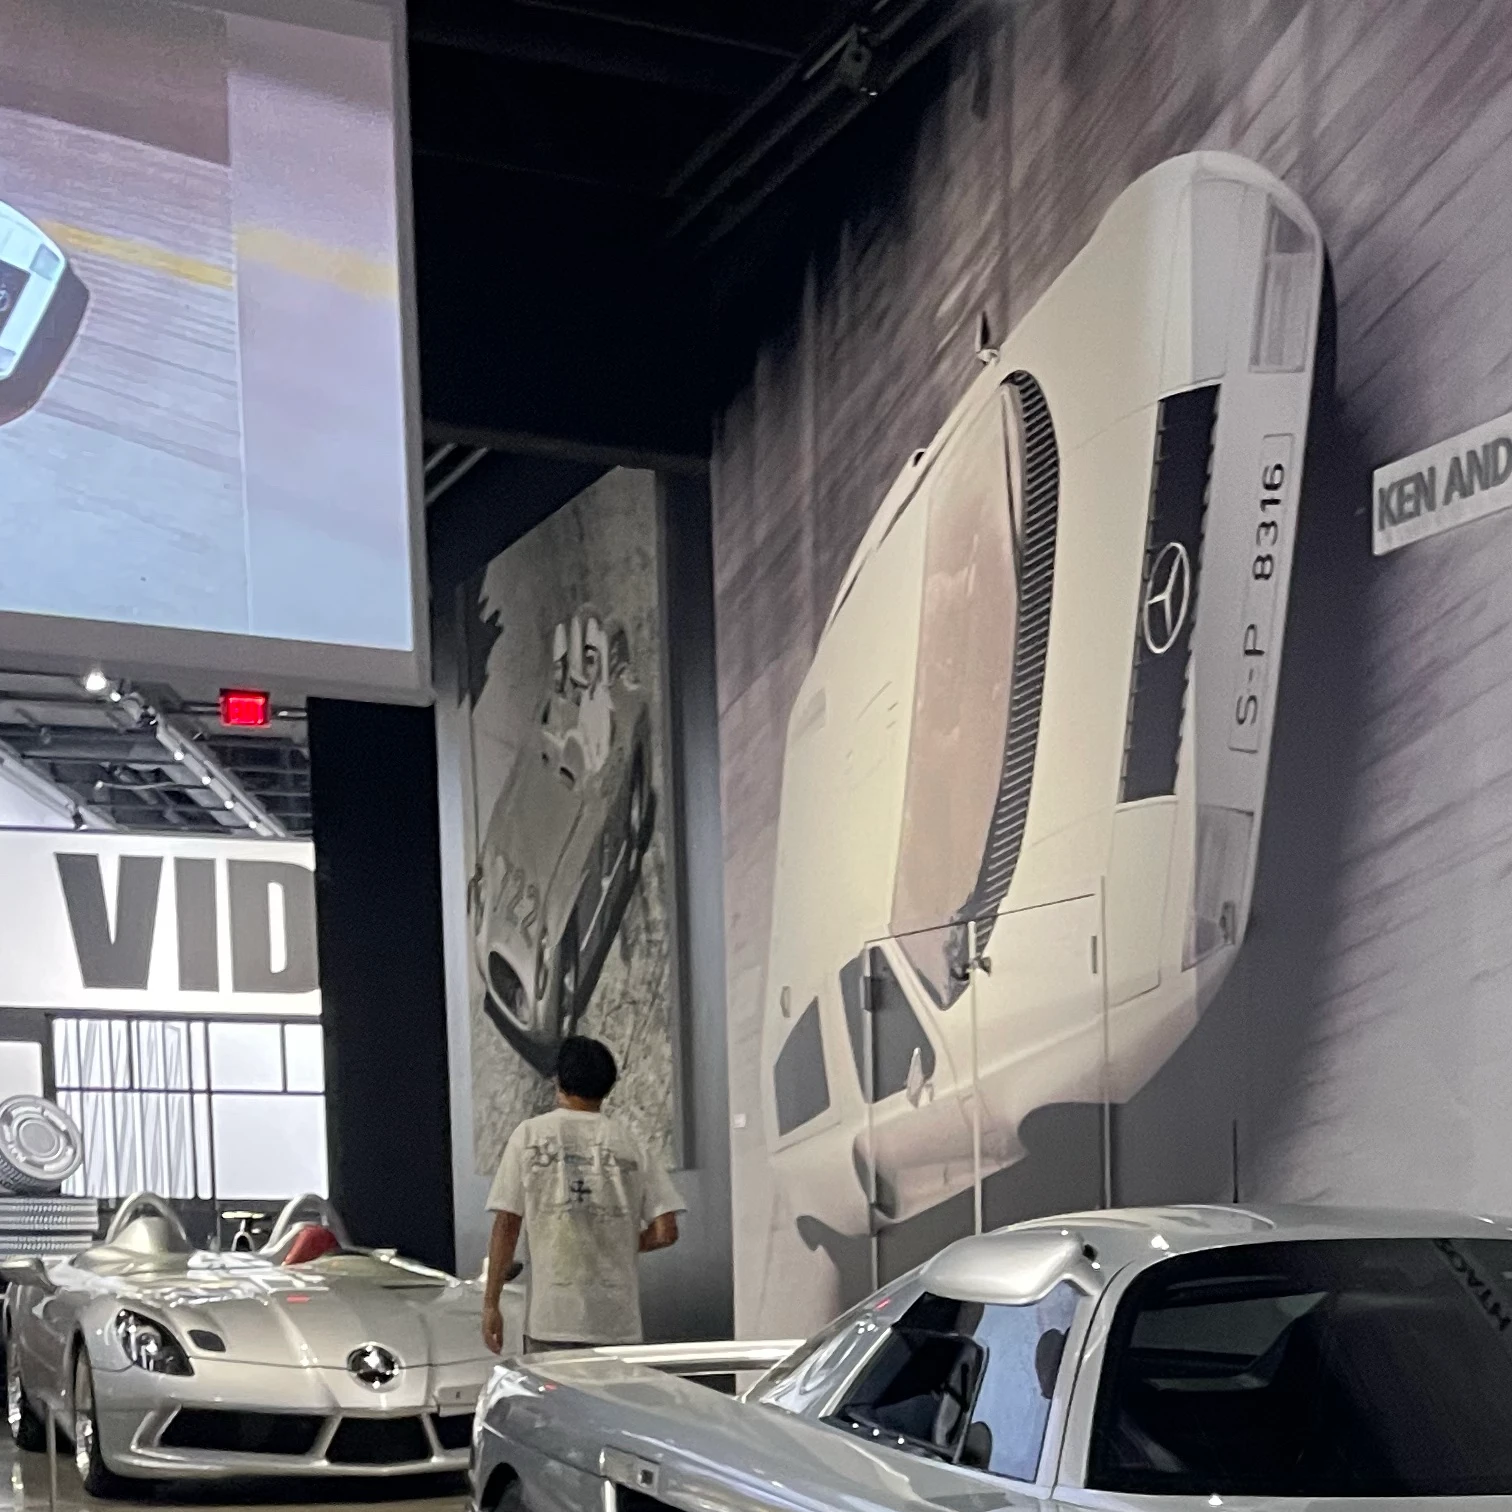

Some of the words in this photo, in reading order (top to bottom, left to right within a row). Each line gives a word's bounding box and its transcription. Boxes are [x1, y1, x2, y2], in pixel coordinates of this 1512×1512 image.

[1377, 467, 1436, 530] KEN
[1236, 624, 1265, 725] S-P
[1253, 463, 1284, 580] 8316
